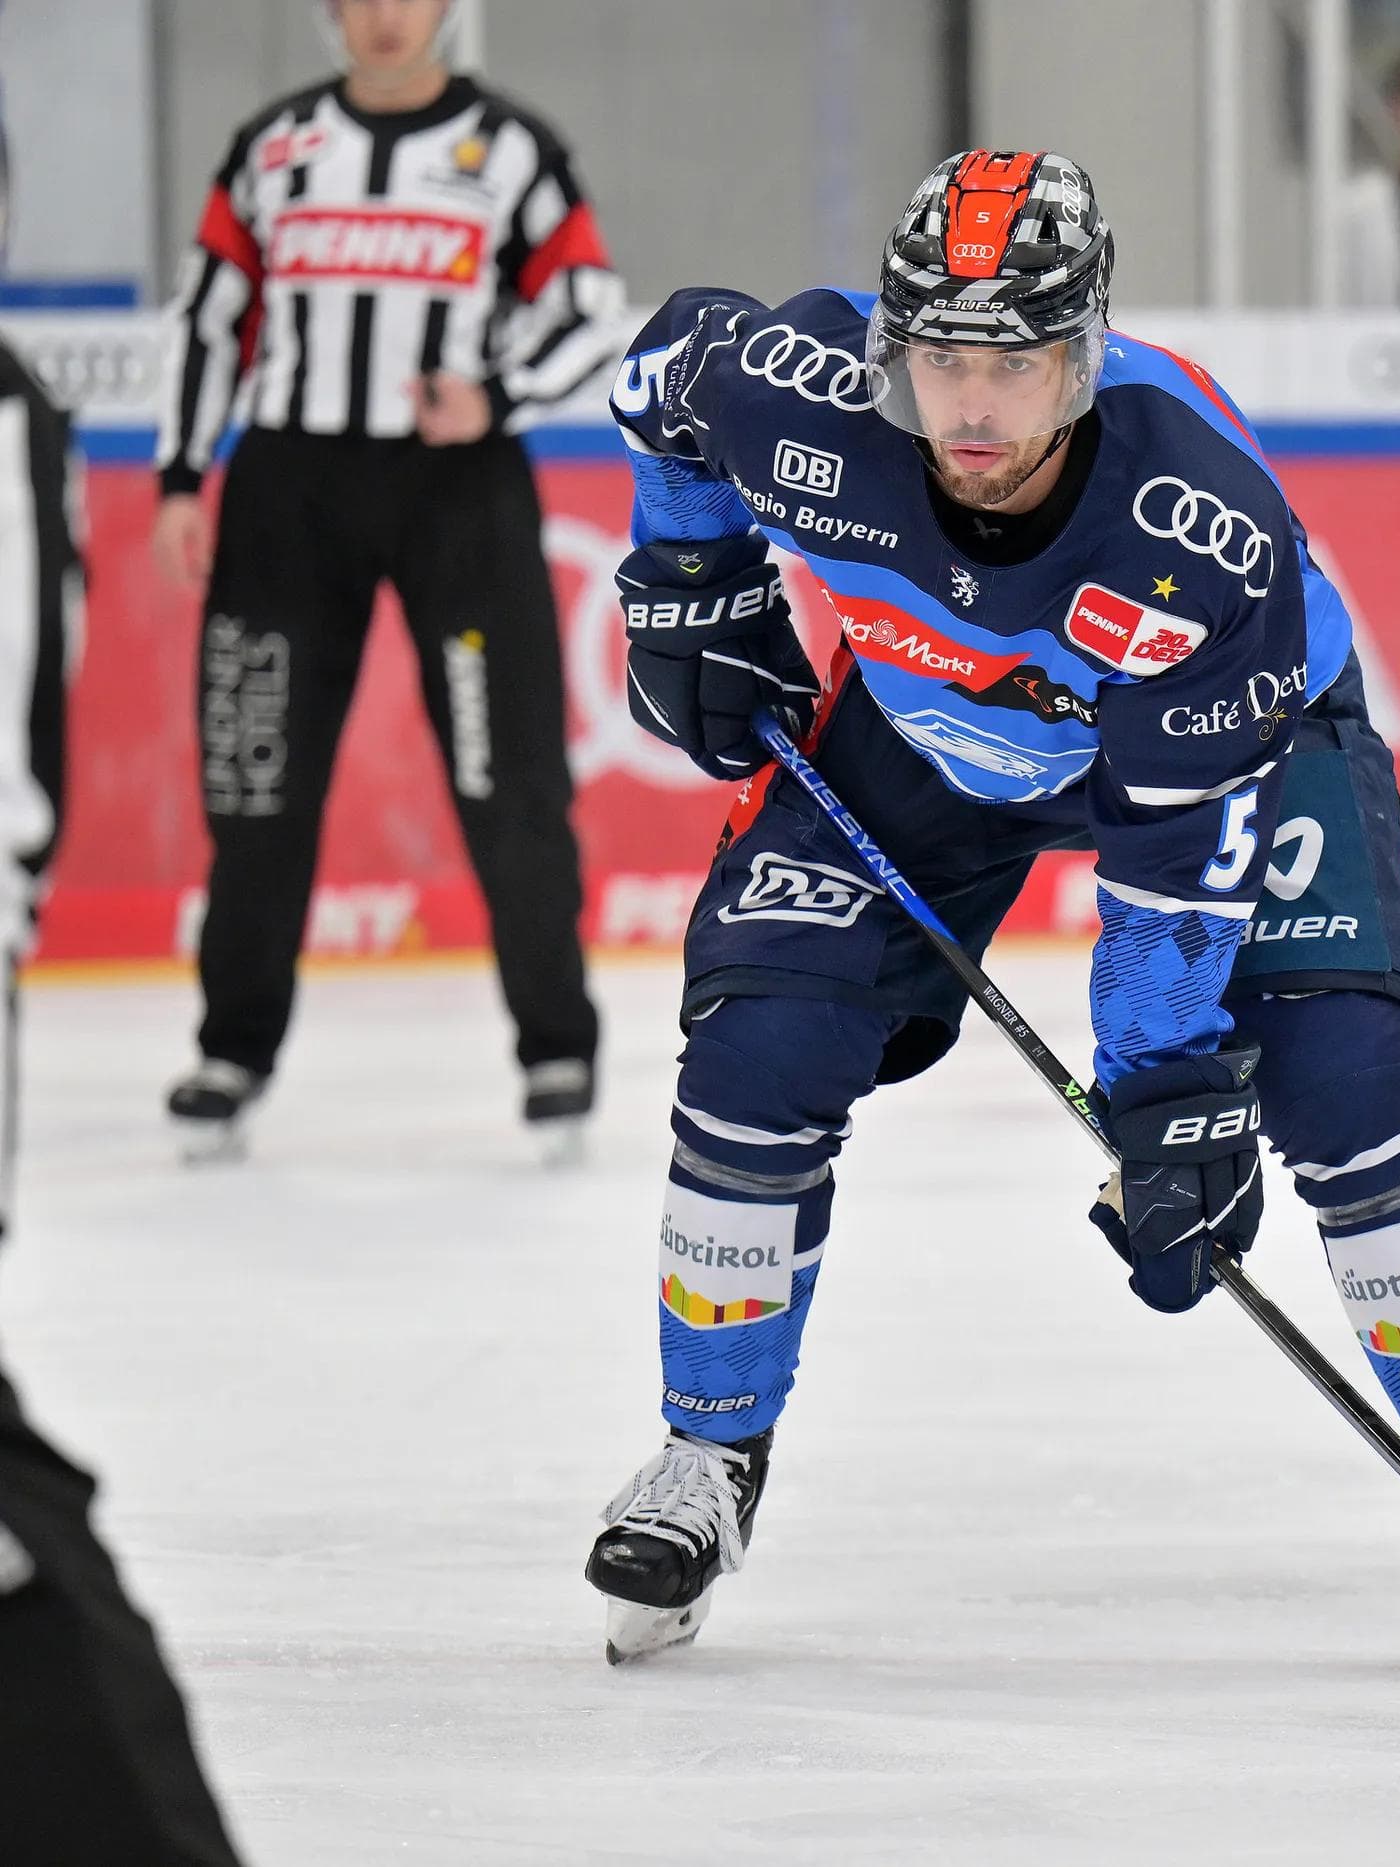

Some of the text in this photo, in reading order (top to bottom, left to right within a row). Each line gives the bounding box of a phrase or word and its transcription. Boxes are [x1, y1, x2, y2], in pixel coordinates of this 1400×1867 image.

[976, 212, 990, 224] 5
[933, 299, 1005, 314] BAUER
[780, 447, 832, 488] DB
[732, 473, 899, 549] Regio Bayern
[891, 634, 977, 677] Markt
[1148, 628, 1190, 650] 30
[1161, 696, 1241, 737] Café
[838, 811, 920, 903] SYNC
[1199, 784, 1259, 893] 5
[982, 984, 1031, 1038] WAGNER #5
[666, 1392, 757, 1414] BAUER
